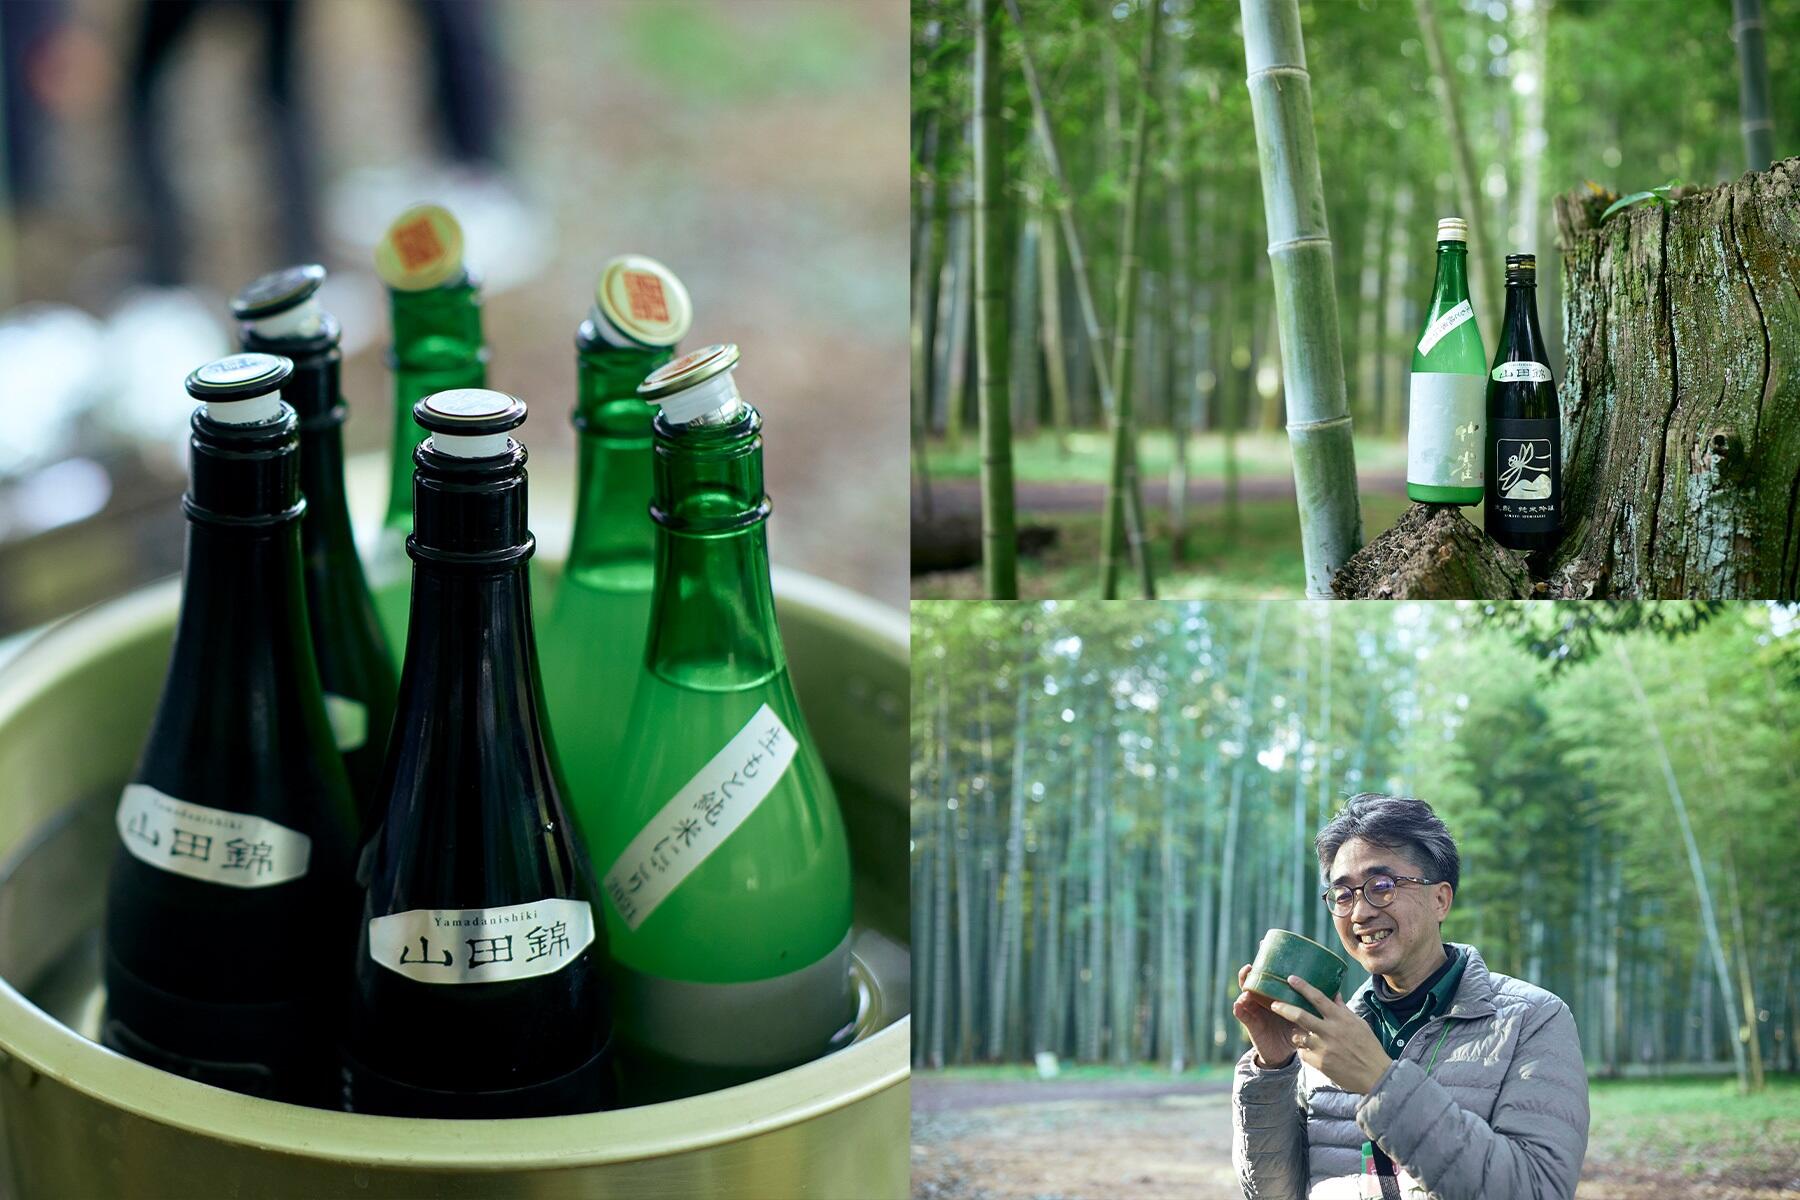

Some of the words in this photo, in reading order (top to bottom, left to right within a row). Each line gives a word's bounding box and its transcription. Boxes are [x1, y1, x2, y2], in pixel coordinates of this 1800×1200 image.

[127, 811, 273, 876] 山田錦
[435, 910, 538, 927] Yamadanishiki
[400, 921, 570, 969] 山田錦
